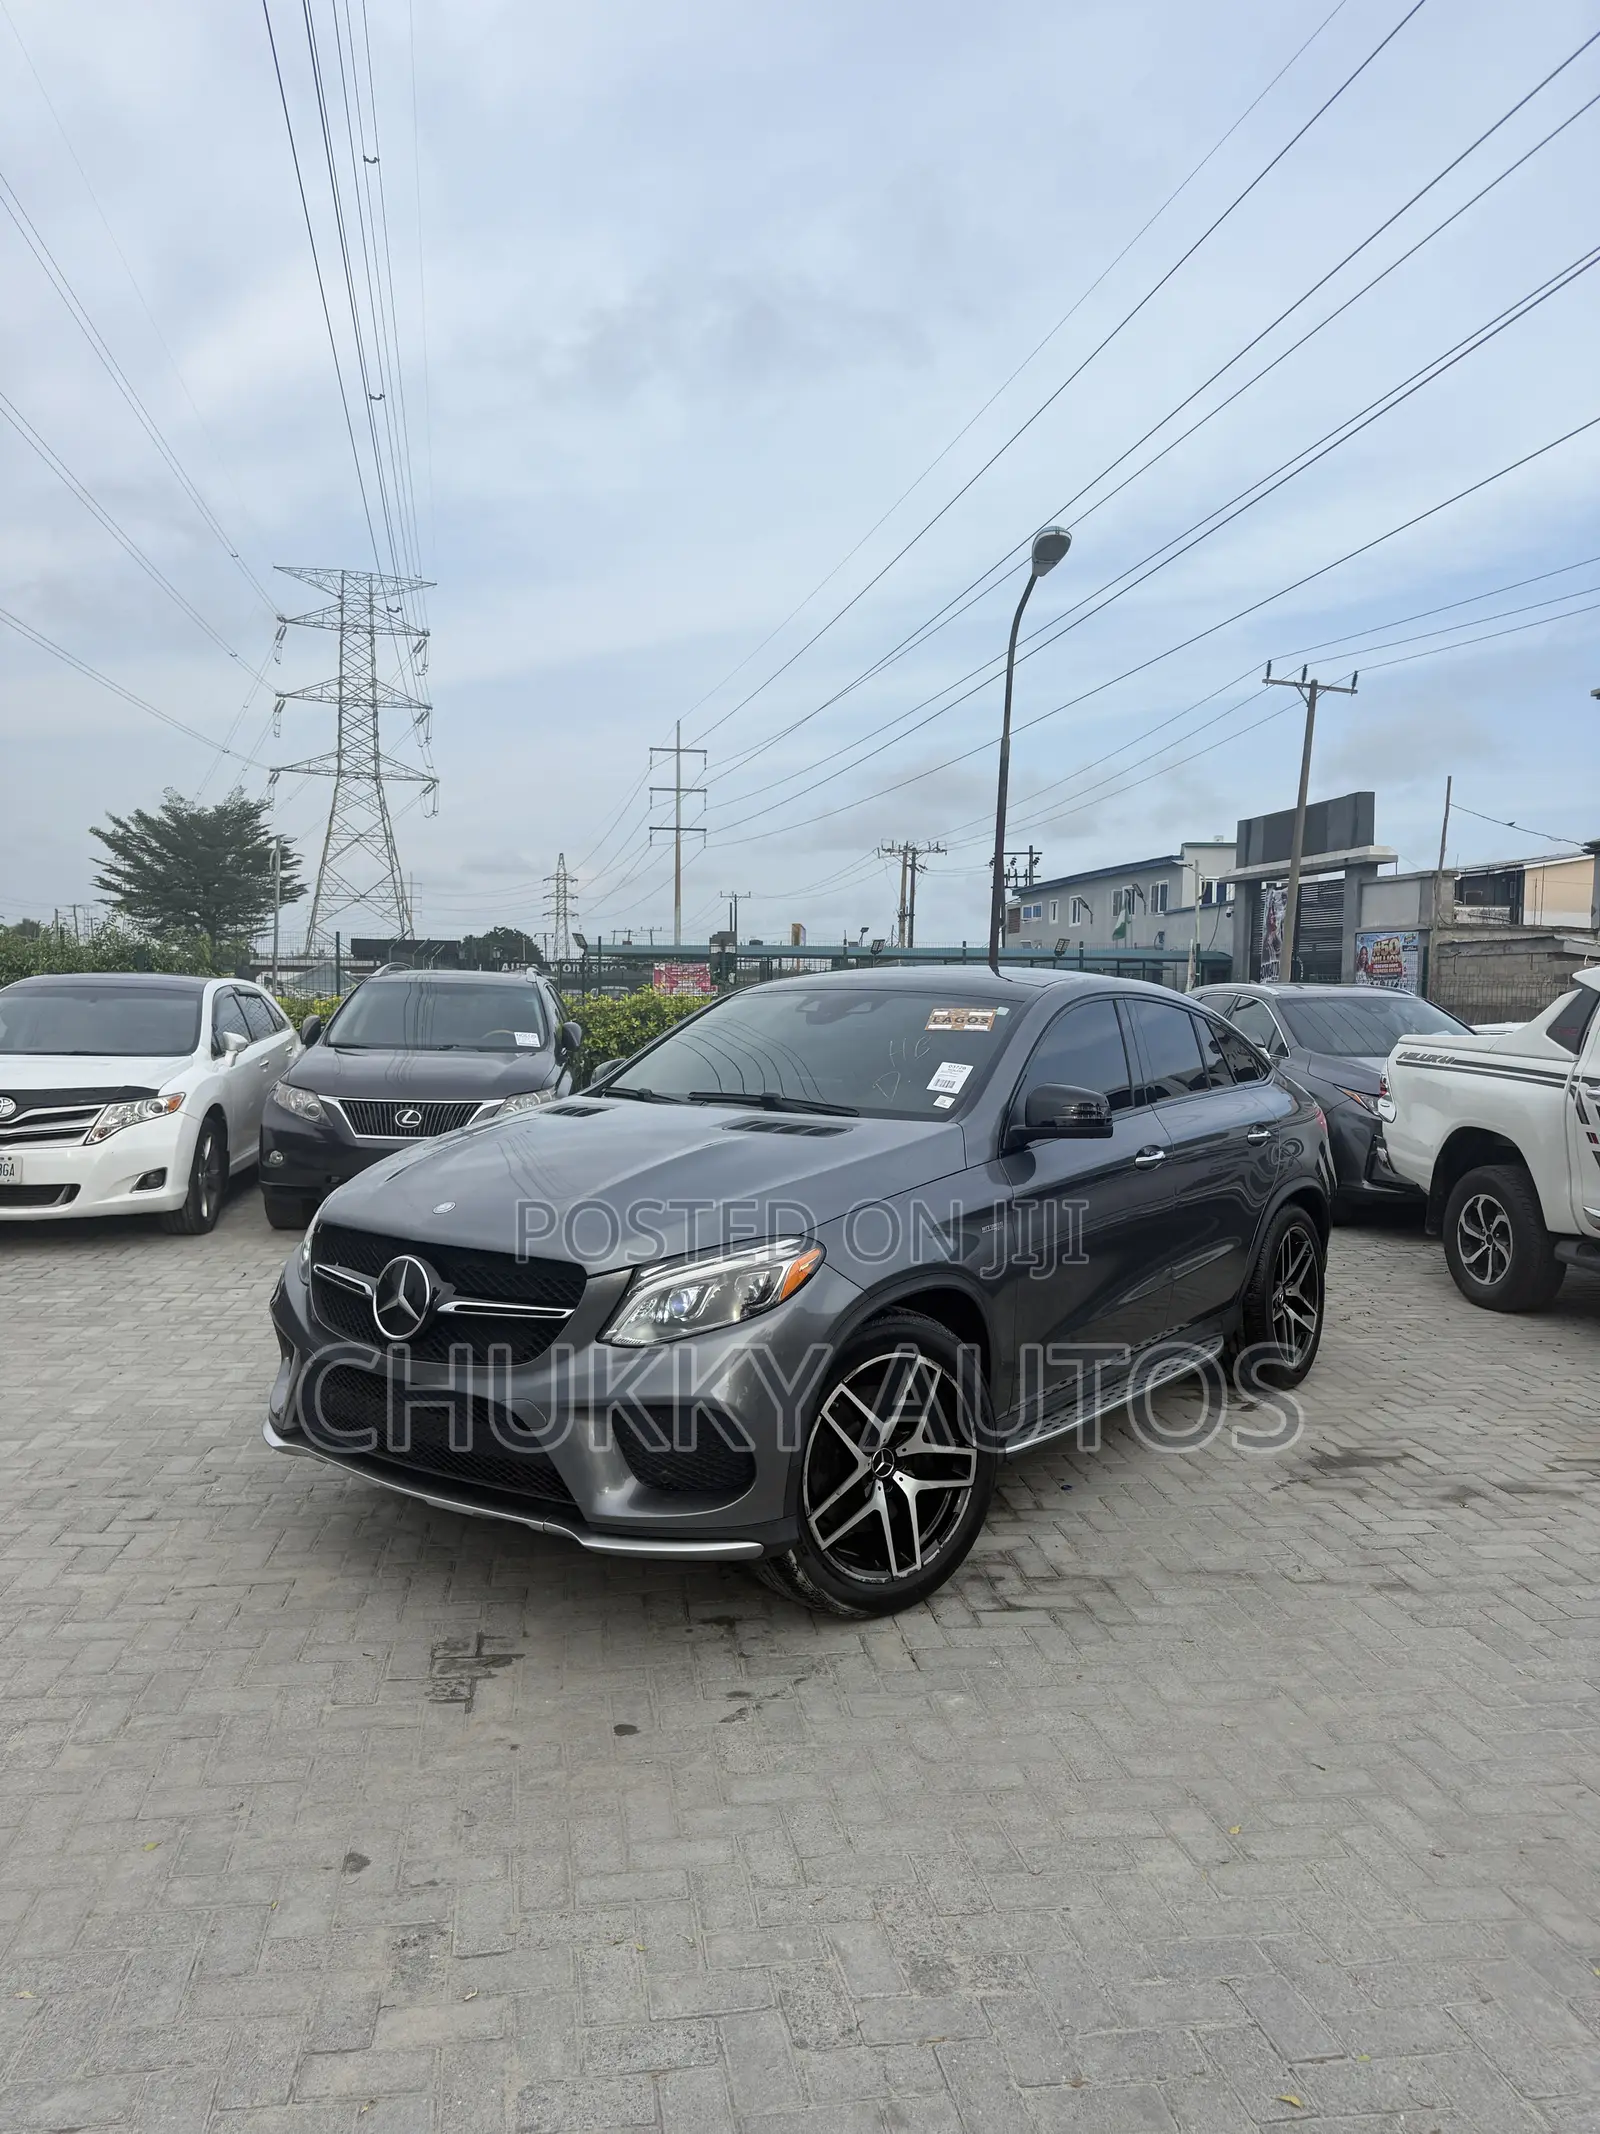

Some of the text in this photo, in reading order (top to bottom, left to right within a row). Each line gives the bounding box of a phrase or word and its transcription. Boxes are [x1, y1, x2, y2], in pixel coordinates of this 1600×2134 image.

[1371, 955, 1400, 964] MILLION
[501, 962, 628, 974] AUT WORSHOP
[932, 1016, 989, 1024] LAGOS
